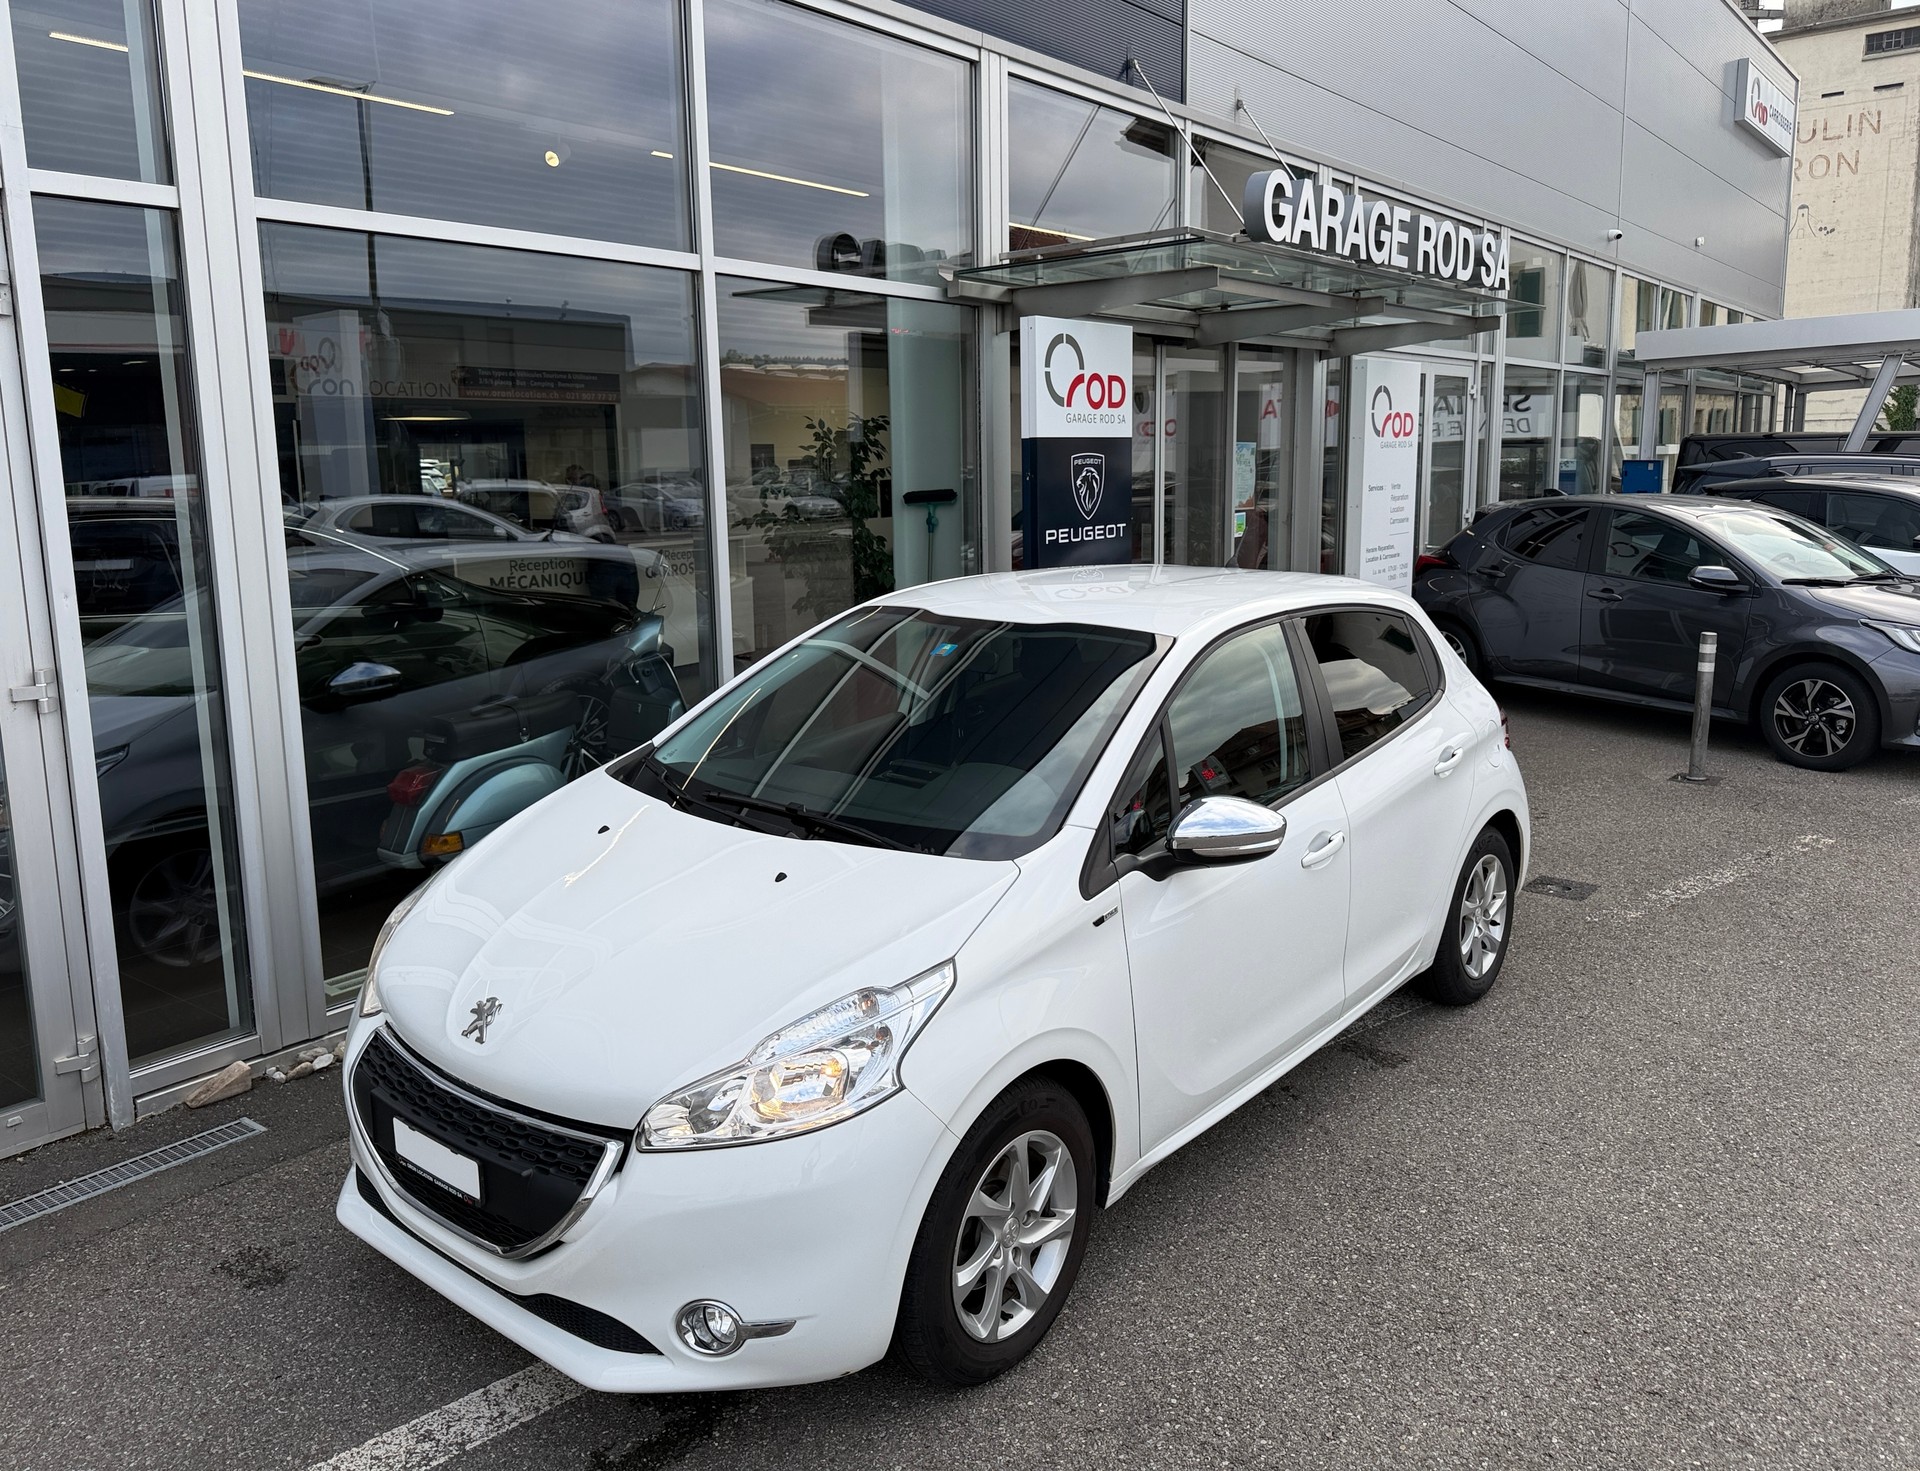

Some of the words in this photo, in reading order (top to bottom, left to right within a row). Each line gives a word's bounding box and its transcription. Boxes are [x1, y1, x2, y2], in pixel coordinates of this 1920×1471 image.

[1769, 104, 1792, 135] CARROSSERIE
[1263, 168, 1412, 269] GARAGE
[1417, 213, 1475, 282] ROD
[1480, 232, 1511, 291] SA
[1065, 413, 1098, 424] GARAGE
[1099, 413, 1116, 424] ROD
[1117, 414, 1127, 424] SA
[1380, 441, 1397, 449] GARAGE
[1398, 441, 1407, 449] ROD
[1073, 458, 1102, 466] PEUGEOT
[1368, 484, 1384, 492] Services
[1045, 523, 1127, 545] PEUGEOT
[509, 557, 575, 574] Réception
